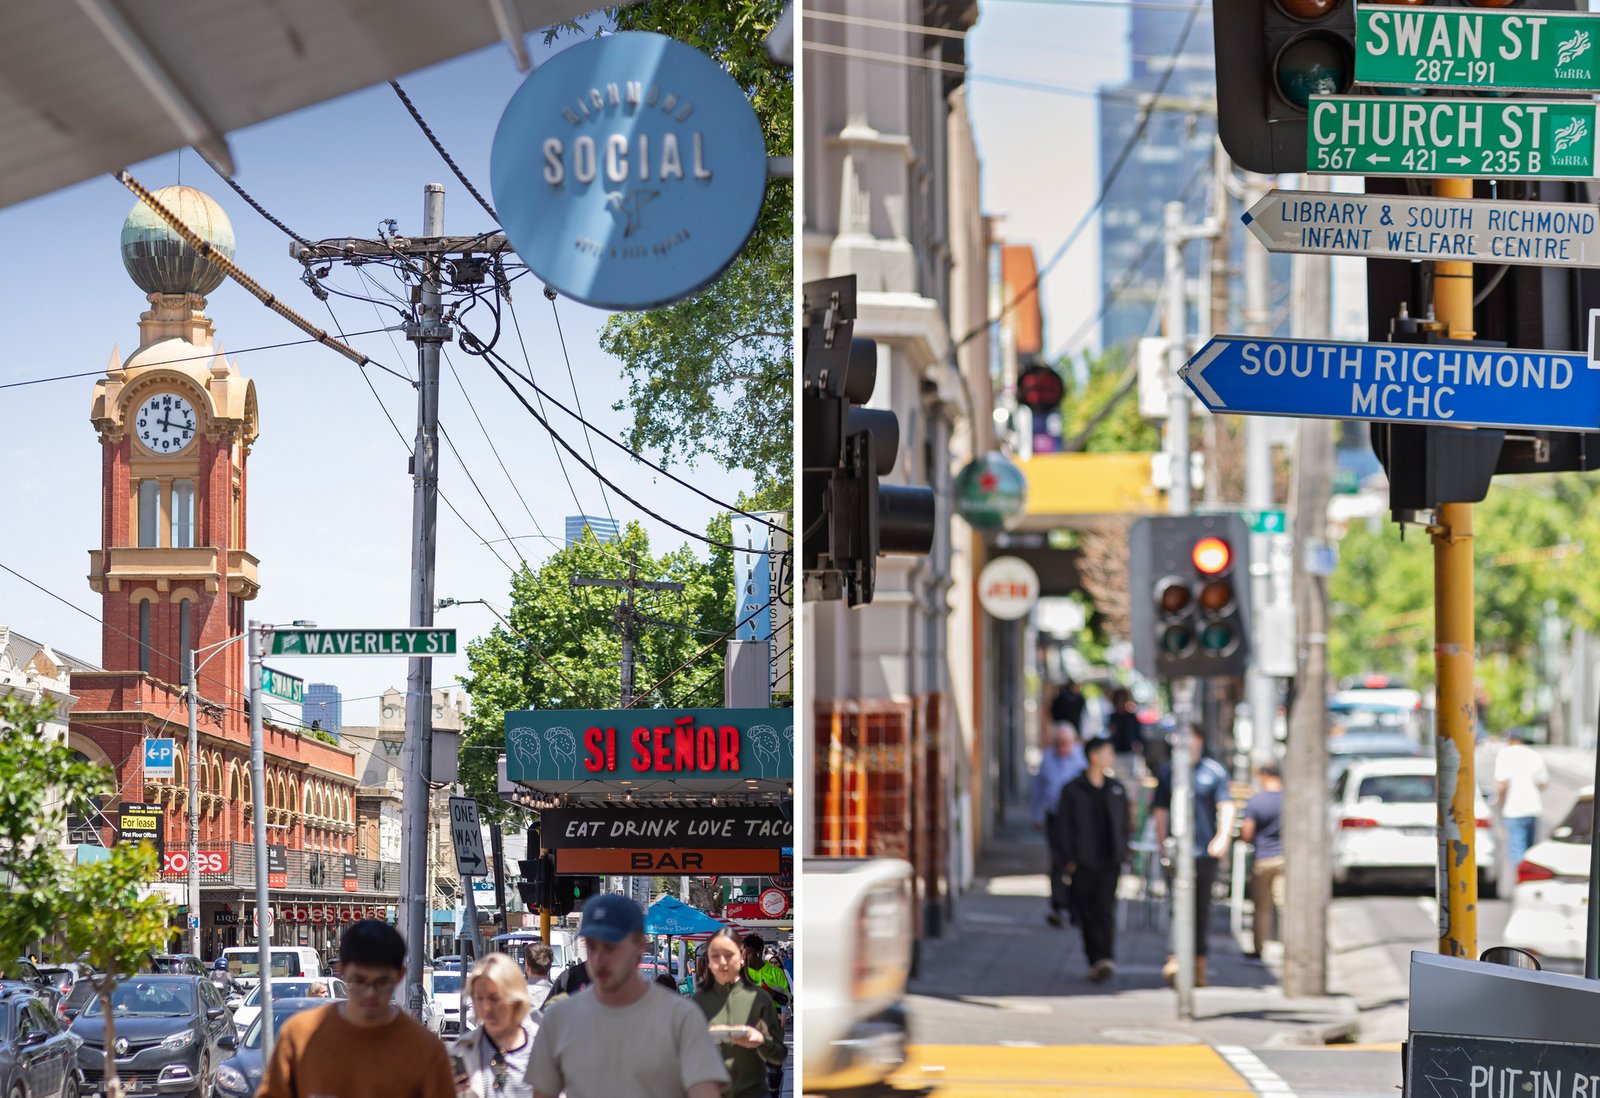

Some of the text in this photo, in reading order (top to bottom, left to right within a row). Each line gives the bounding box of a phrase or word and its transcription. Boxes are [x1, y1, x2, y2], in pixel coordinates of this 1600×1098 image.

[1366, 12, 1548, 61] SWAN ST
[1415, 59, 1495, 83] 287-191
[1313, 102, 1548, 149] CHURCH ST
[543, 132, 713, 185] SOCIAL
[1317, 147, 1541, 173] 567 421 235 B
[1281, 201, 1595, 235] LIBRARY & SOUTH RICHMOND
[1301, 227, 1571, 260] INFANT WELFARE CENTRE
[1240, 342, 1573, 390] SOUTH RICHMOND
[1351, 382, 1456, 419] MCHC
[304, 632, 450, 654] WAVERLEY ST
[271, 672, 303, 701] SWAN ST
[160, 747, 170, 760] P
[584, 716, 741, 772] SI SEÑOR
[122, 817, 155, 828] For lease
[454, 804, 475, 823] ONE
[455, 828, 478, 847] WAY
[565, 821, 605, 838] EAT
[610, 819, 679, 837] DRINK
[687, 819, 735, 837] LOVE
[631, 852, 704, 870] BAR
[1470, 1066, 1522, 1098] PUT
[1530, 1070, 1561, 1098] IN
